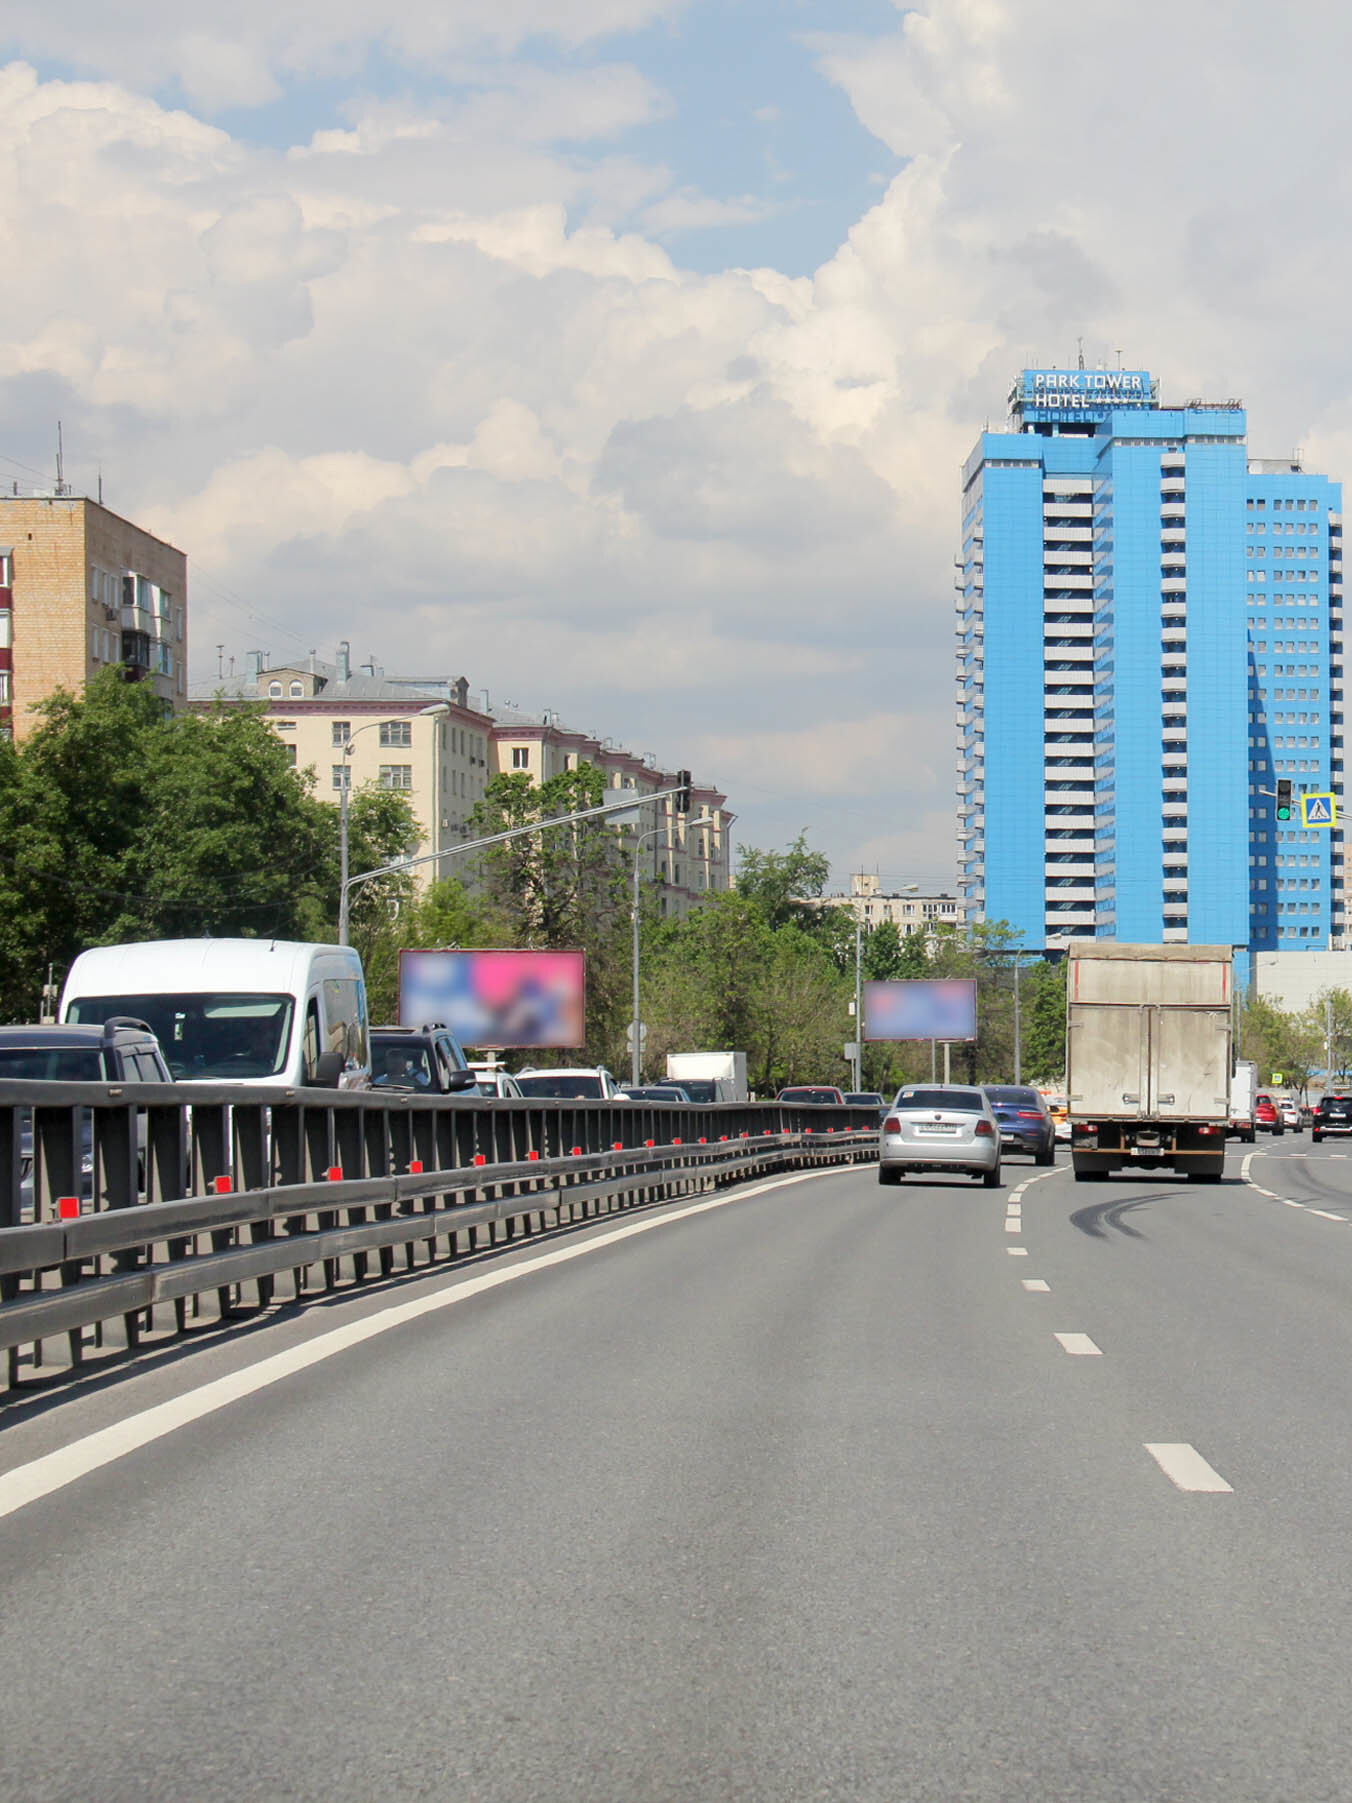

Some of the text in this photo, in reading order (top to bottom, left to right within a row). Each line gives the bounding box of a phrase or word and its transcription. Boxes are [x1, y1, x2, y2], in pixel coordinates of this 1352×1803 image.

[1035, 374, 1141, 389] PARK TOWER
[1035, 394, 1090, 408] HOTEL
